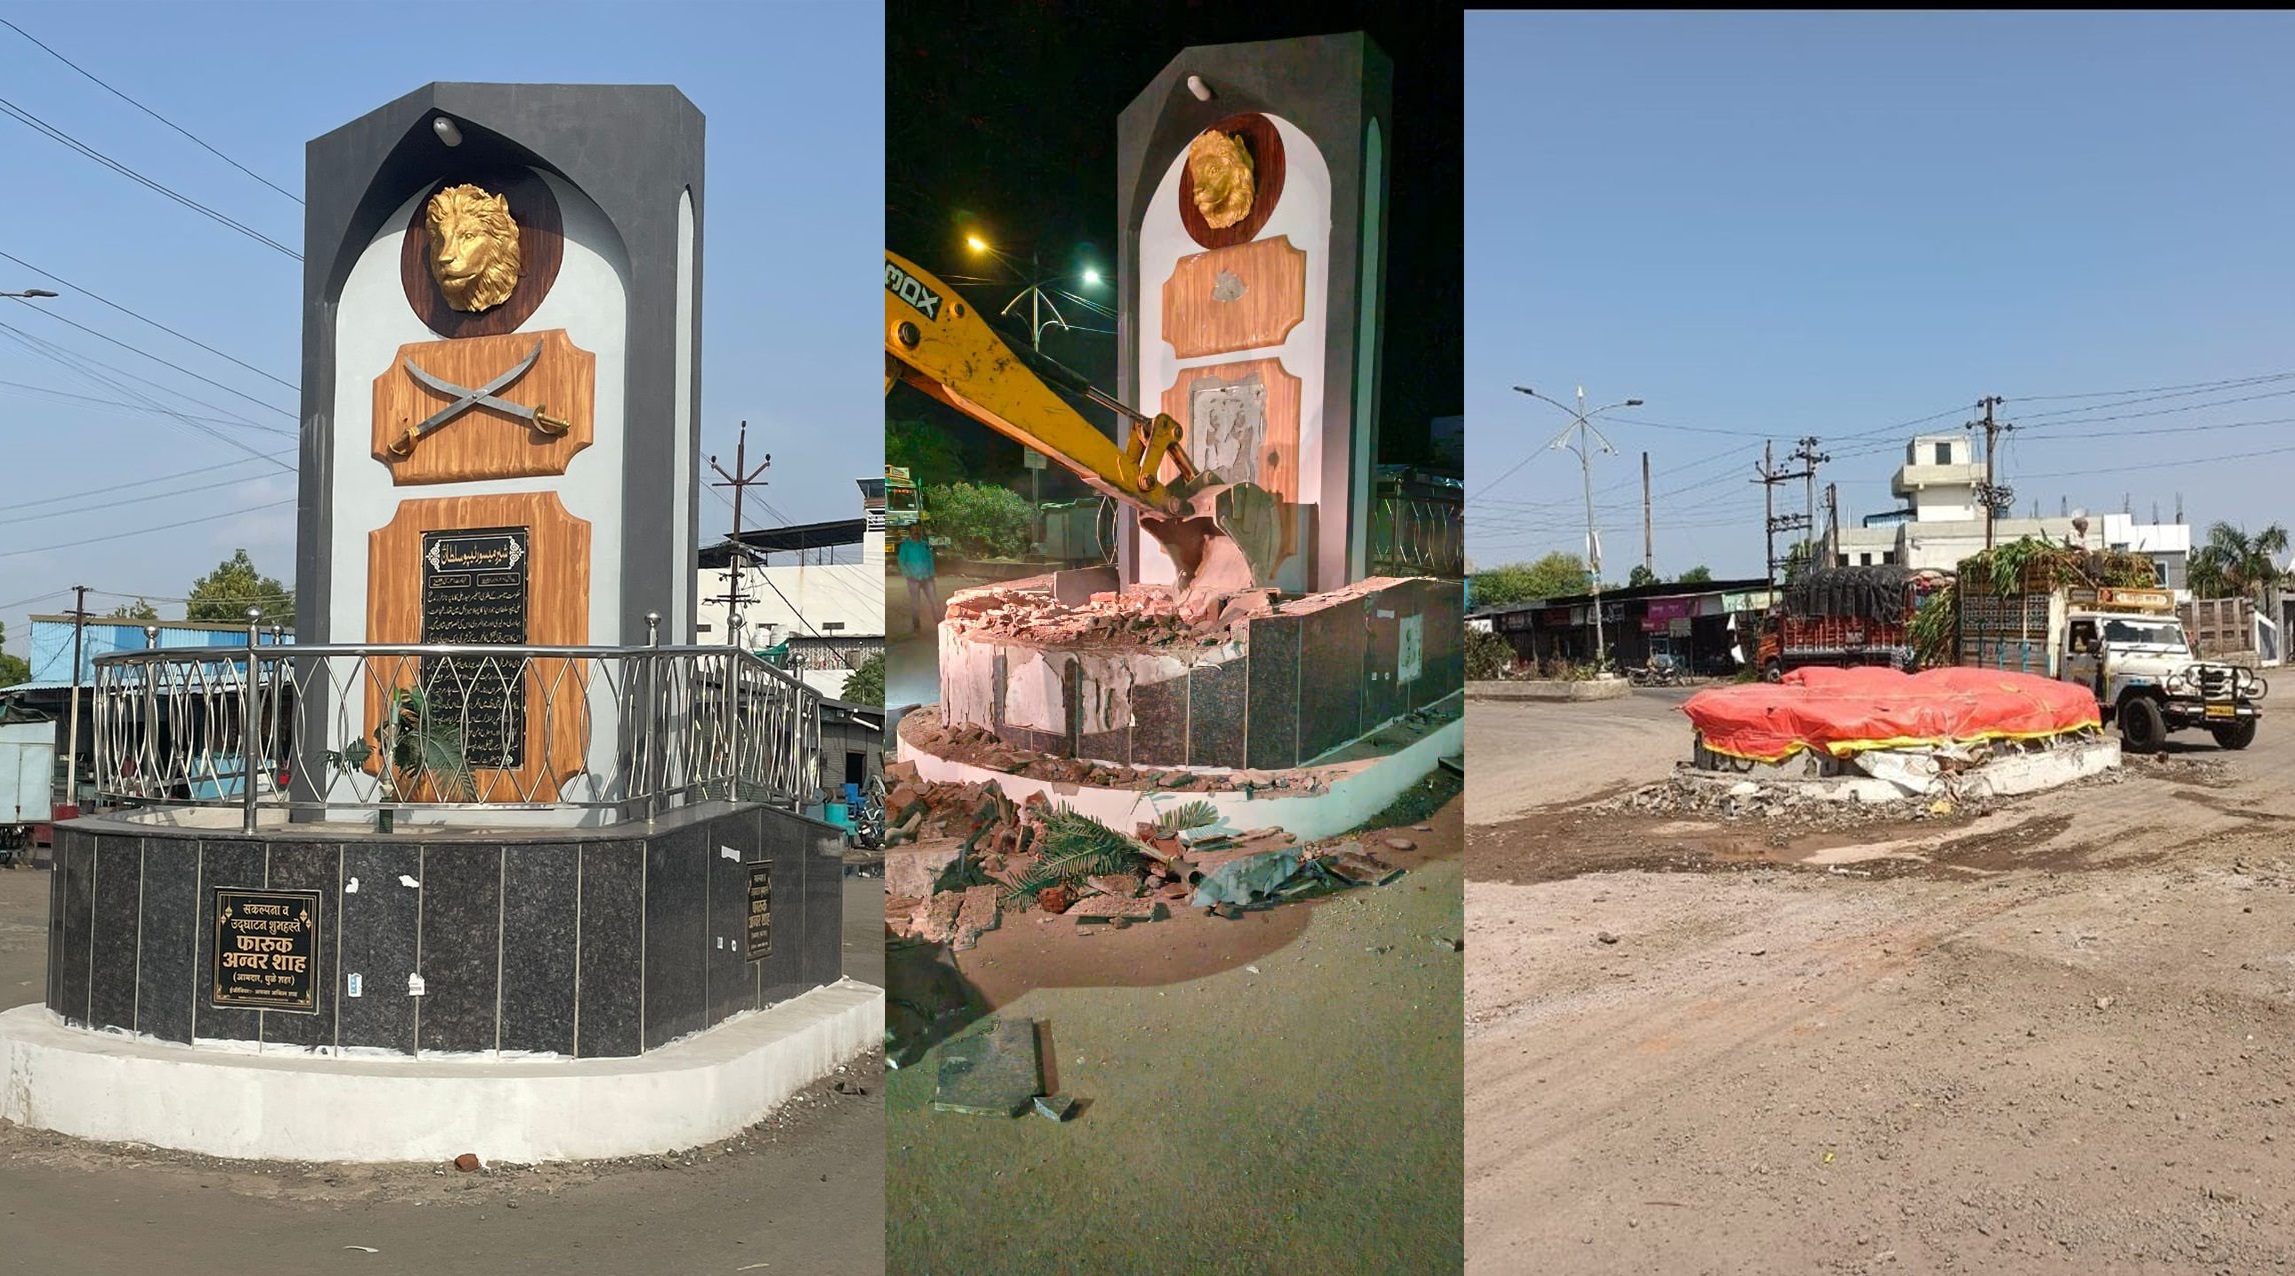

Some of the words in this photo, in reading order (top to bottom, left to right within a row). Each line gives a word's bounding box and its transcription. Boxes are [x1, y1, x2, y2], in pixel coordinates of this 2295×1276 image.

[236, 935, 294, 953] फारुक
[222, 952, 269, 970] अन्वर
[271, 953, 307, 973] शाह
